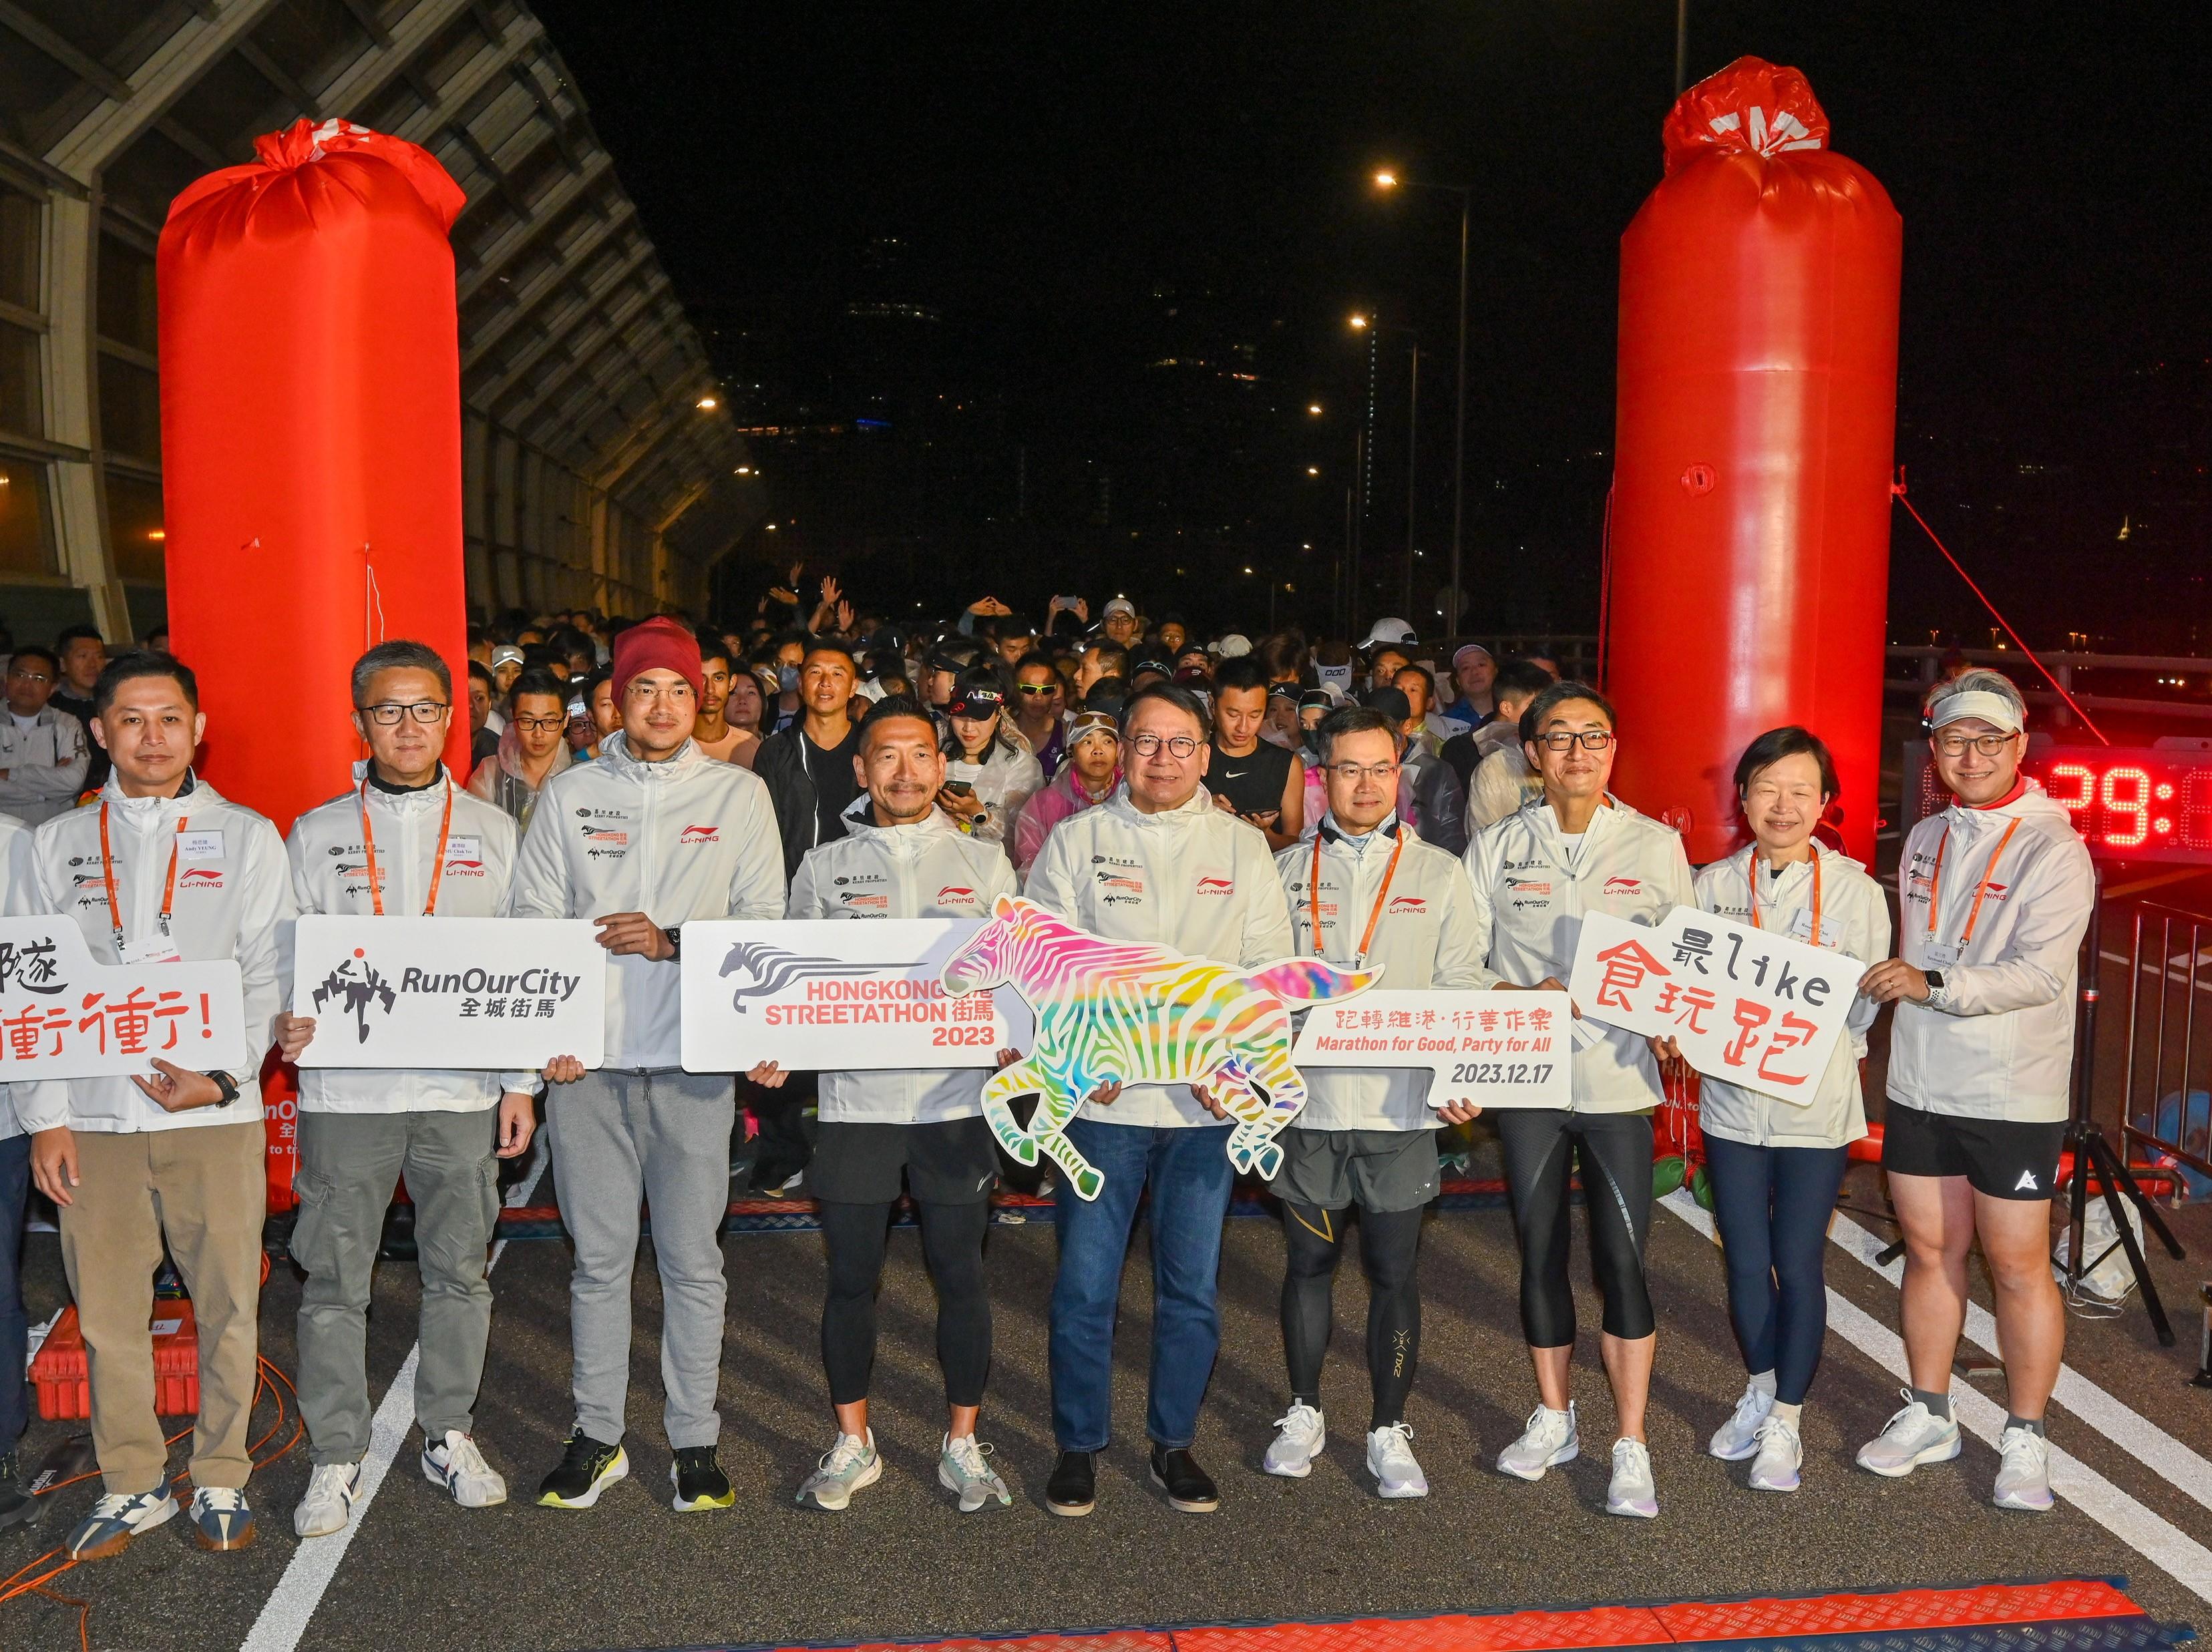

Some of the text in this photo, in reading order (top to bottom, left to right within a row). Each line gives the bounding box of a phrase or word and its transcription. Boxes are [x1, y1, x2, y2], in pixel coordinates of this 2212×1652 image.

[680, 835, 720, 844] LI-NING
[938, 897, 974, 905] LI-NING
[400, 968, 581, 1002] RunOurCity
[807, 979, 944, 1002] HONGKONG
[459, 998, 556, 1018] 全城街馬
[765, 999, 994, 1026] STREETATHON 街馬
[932, 1026, 994, 1046] 2023
[1316, 1036, 1551, 1055] Marathon for Good, Party for All
[1451, 1063, 1553, 1084] 2023.12.17
[1687, 1102, 1699, 1112] to
[270, 1145, 283, 1155] to
[1393, 1352, 1404, 1378] 2XU
